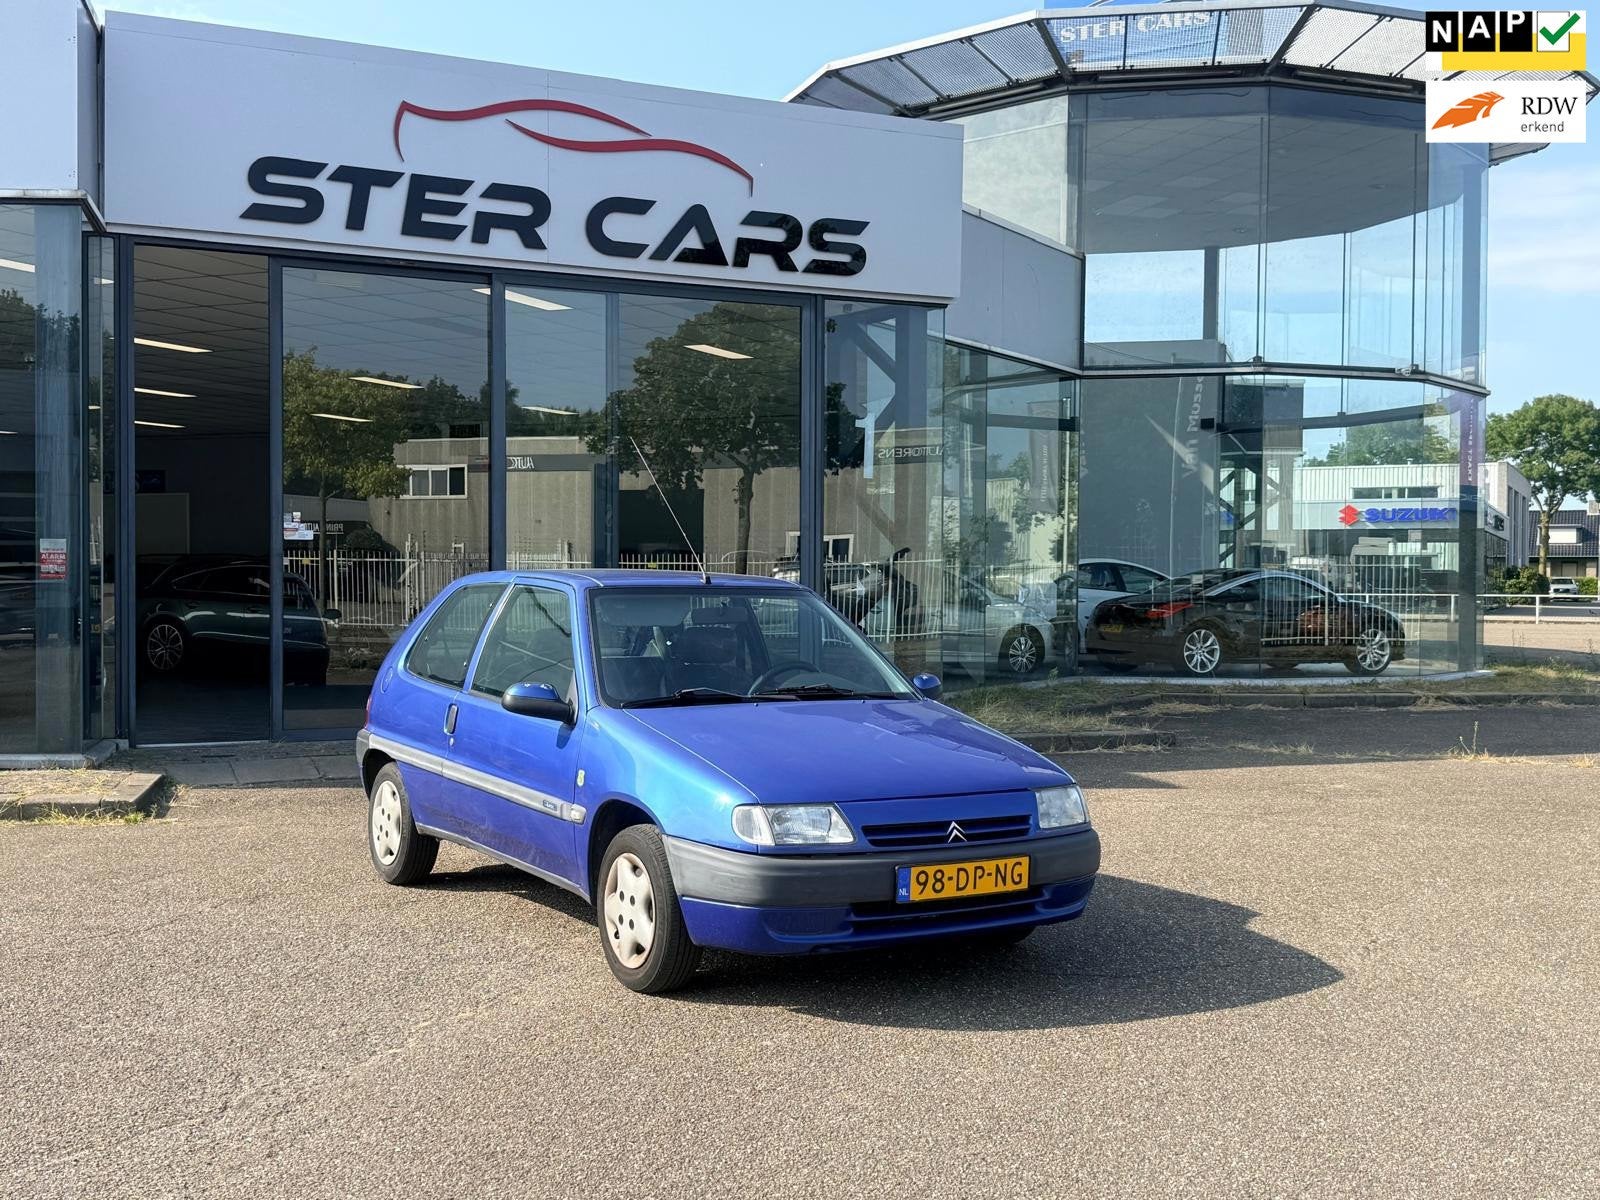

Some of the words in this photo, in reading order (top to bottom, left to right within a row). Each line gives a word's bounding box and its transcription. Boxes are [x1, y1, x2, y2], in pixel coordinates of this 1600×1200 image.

[1060, 20, 1126, 43] STER
[1137, 12, 1210, 32] CARS
[239, 155, 552, 250] STER
[585, 196, 871, 276] CARS
[1364, 507, 1458, 523] SUZUKI
[899, 888, 909, 896] NL
[915, 862, 1023, 895] 98-DP-NG
